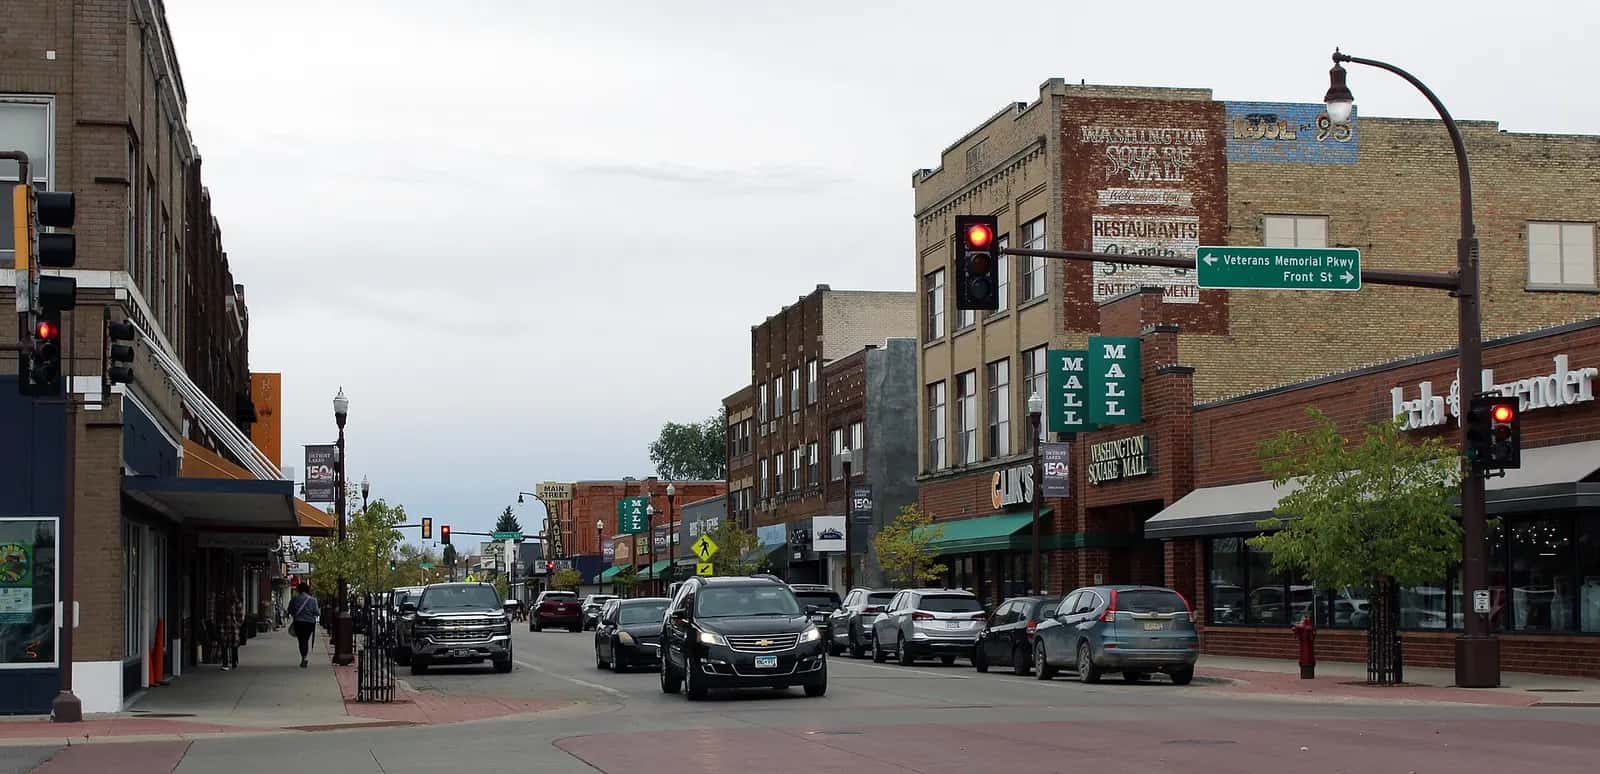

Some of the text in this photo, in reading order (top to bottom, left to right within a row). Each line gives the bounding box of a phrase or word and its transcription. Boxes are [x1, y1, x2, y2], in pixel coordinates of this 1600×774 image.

[1080, 126, 1208, 146] WASHINGTON
[1105, 145, 1192, 180] SQUARE
[1128, 161, 1185, 182] MALL
[1094, 220, 1197, 239] RESTAURANTS
[1223, 254, 1355, 269] Veterans Memorial Pkwy
[1283, 271, 1333, 282] Front St
[1098, 282, 1196, 297] ENTEMENT
[1062, 357, 1083, 424] MALL
[1103, 345, 1126, 415] MALL
[1091, 436, 1144, 461] WASHINGTON
[1088, 455, 1147, 485] SQUARE MALL
[991, 464, 1034, 509] GLIK'S
[631, 499, 642, 530] MALL
